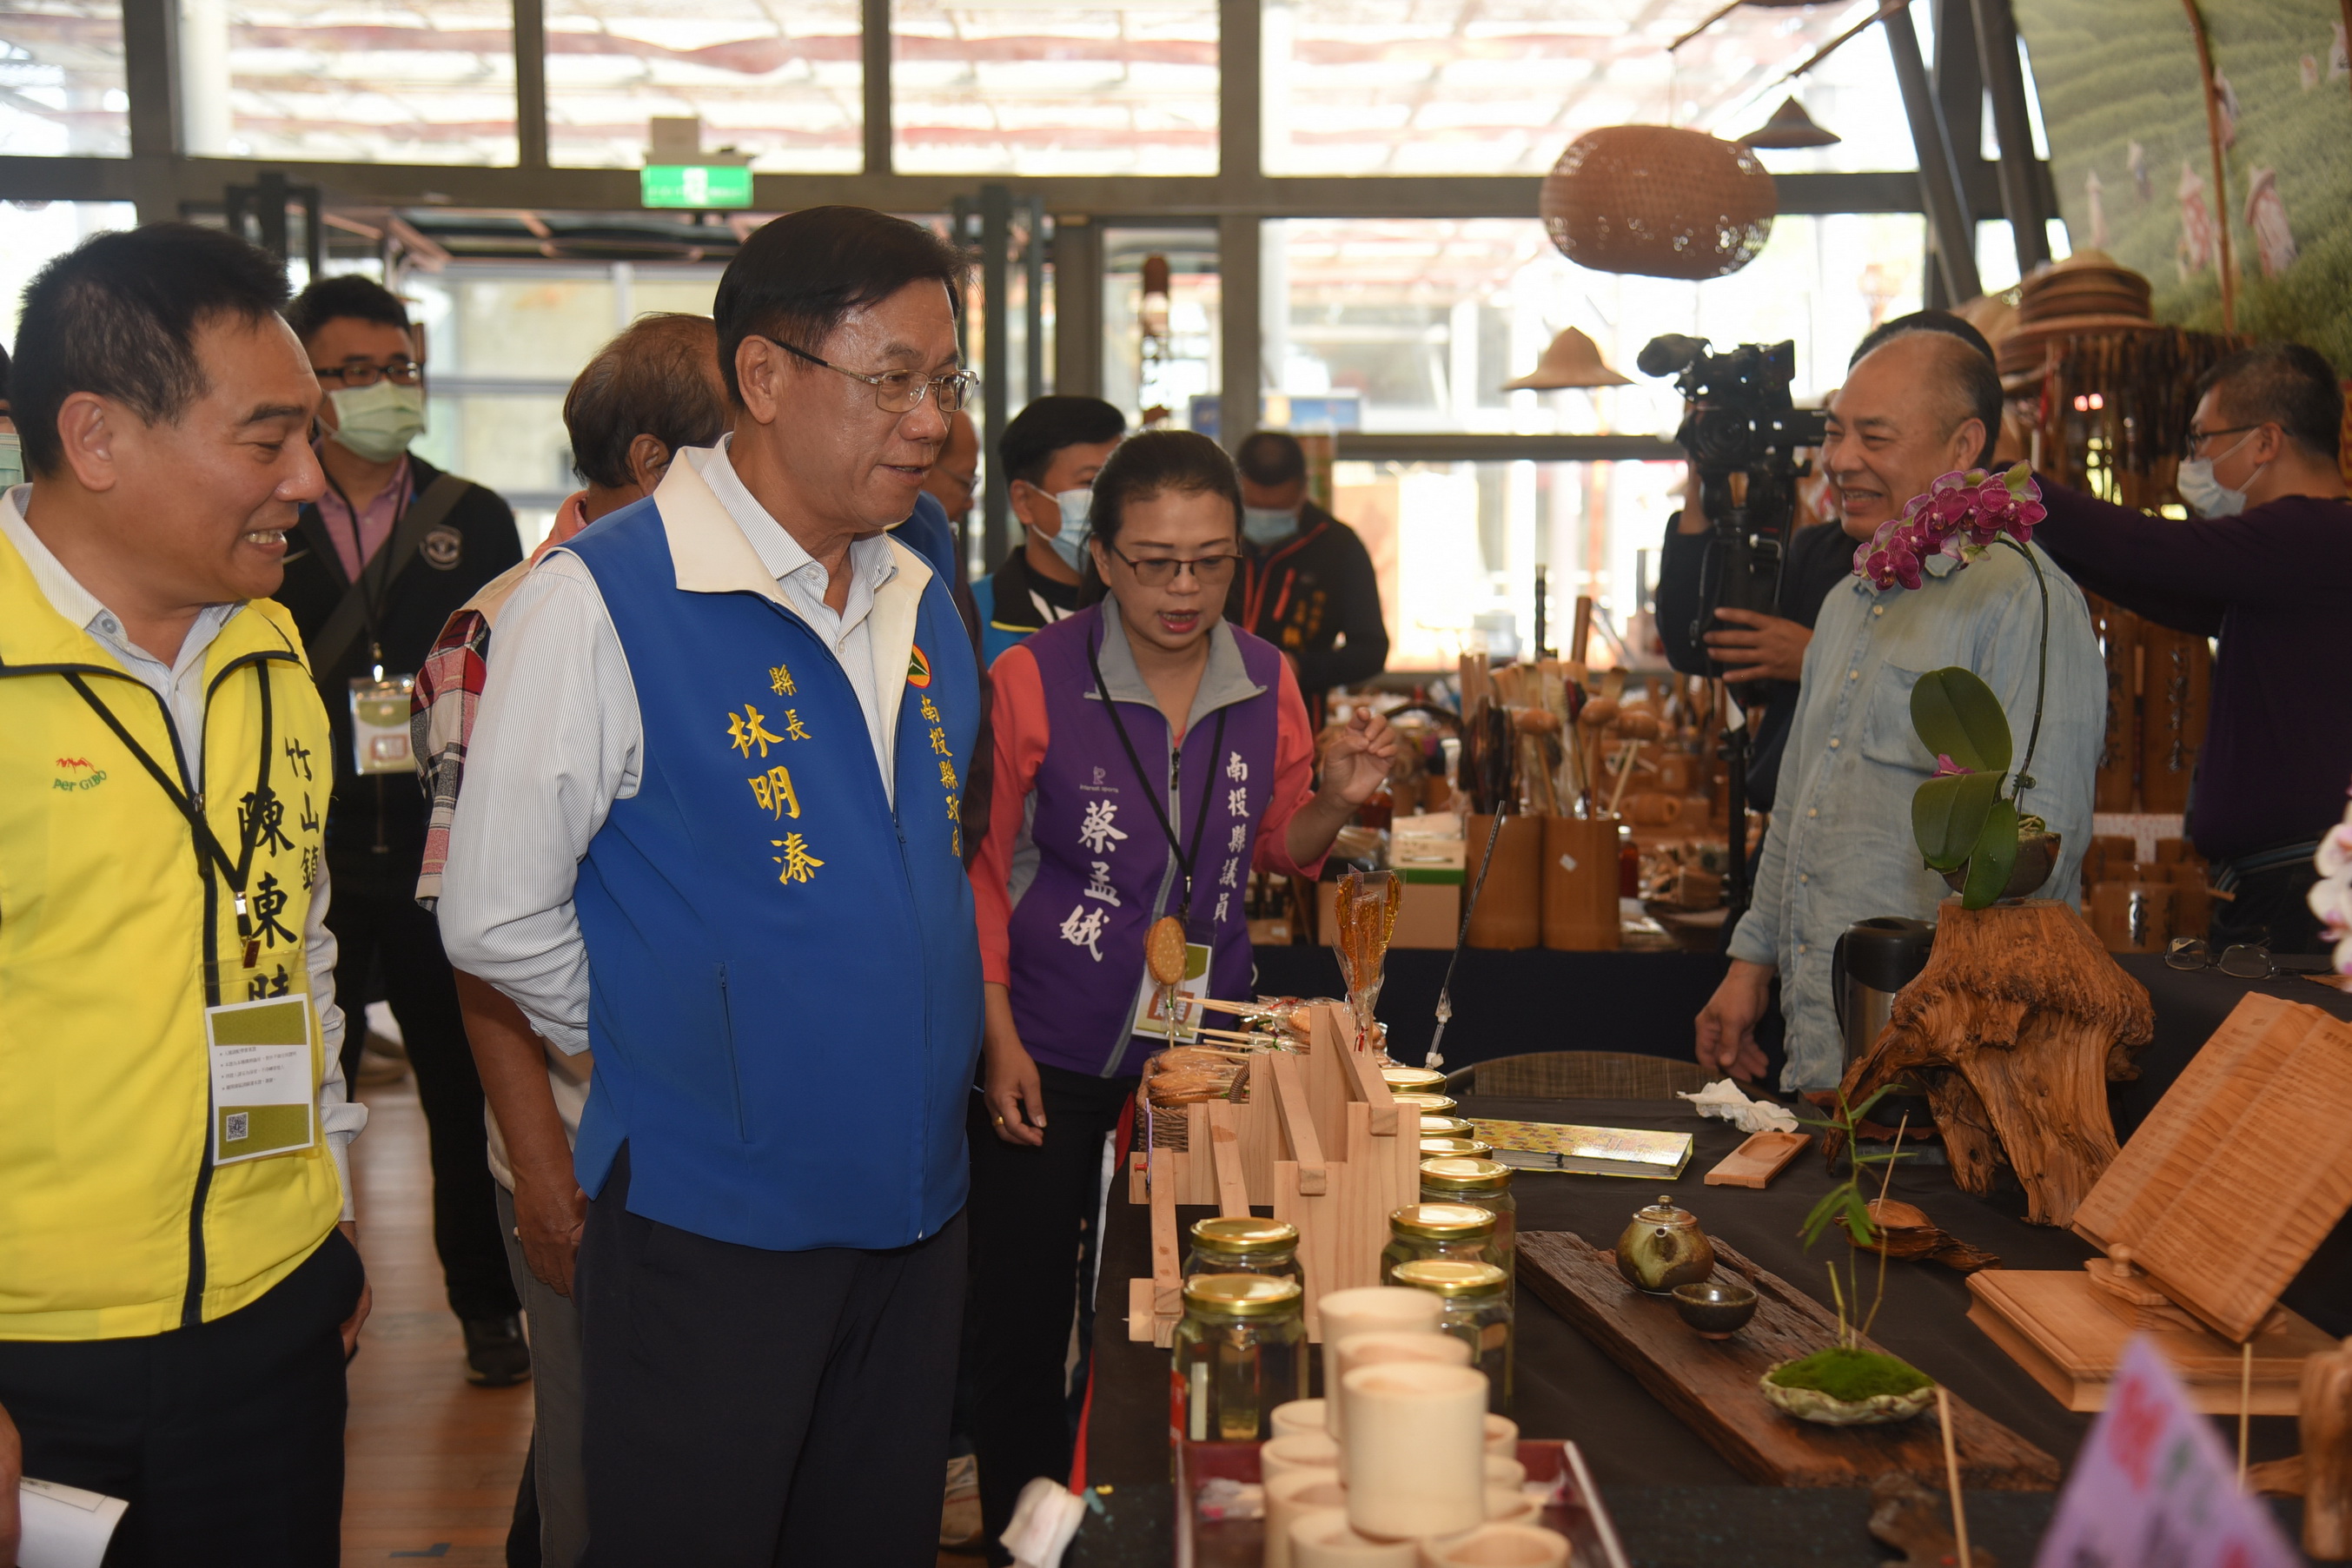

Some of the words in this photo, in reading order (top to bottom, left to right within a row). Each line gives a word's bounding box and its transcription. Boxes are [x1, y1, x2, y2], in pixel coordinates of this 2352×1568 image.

[768, 663, 812, 742] 縣長
[919, 693, 961, 858] 南投縣政府
[284, 736, 320, 895] 竹山鎮
[726, 703, 825, 886] 林明溱
[1212, 751, 1250, 923] 南投縣議員
[1058, 798, 1129, 963] 蔡孟娥
